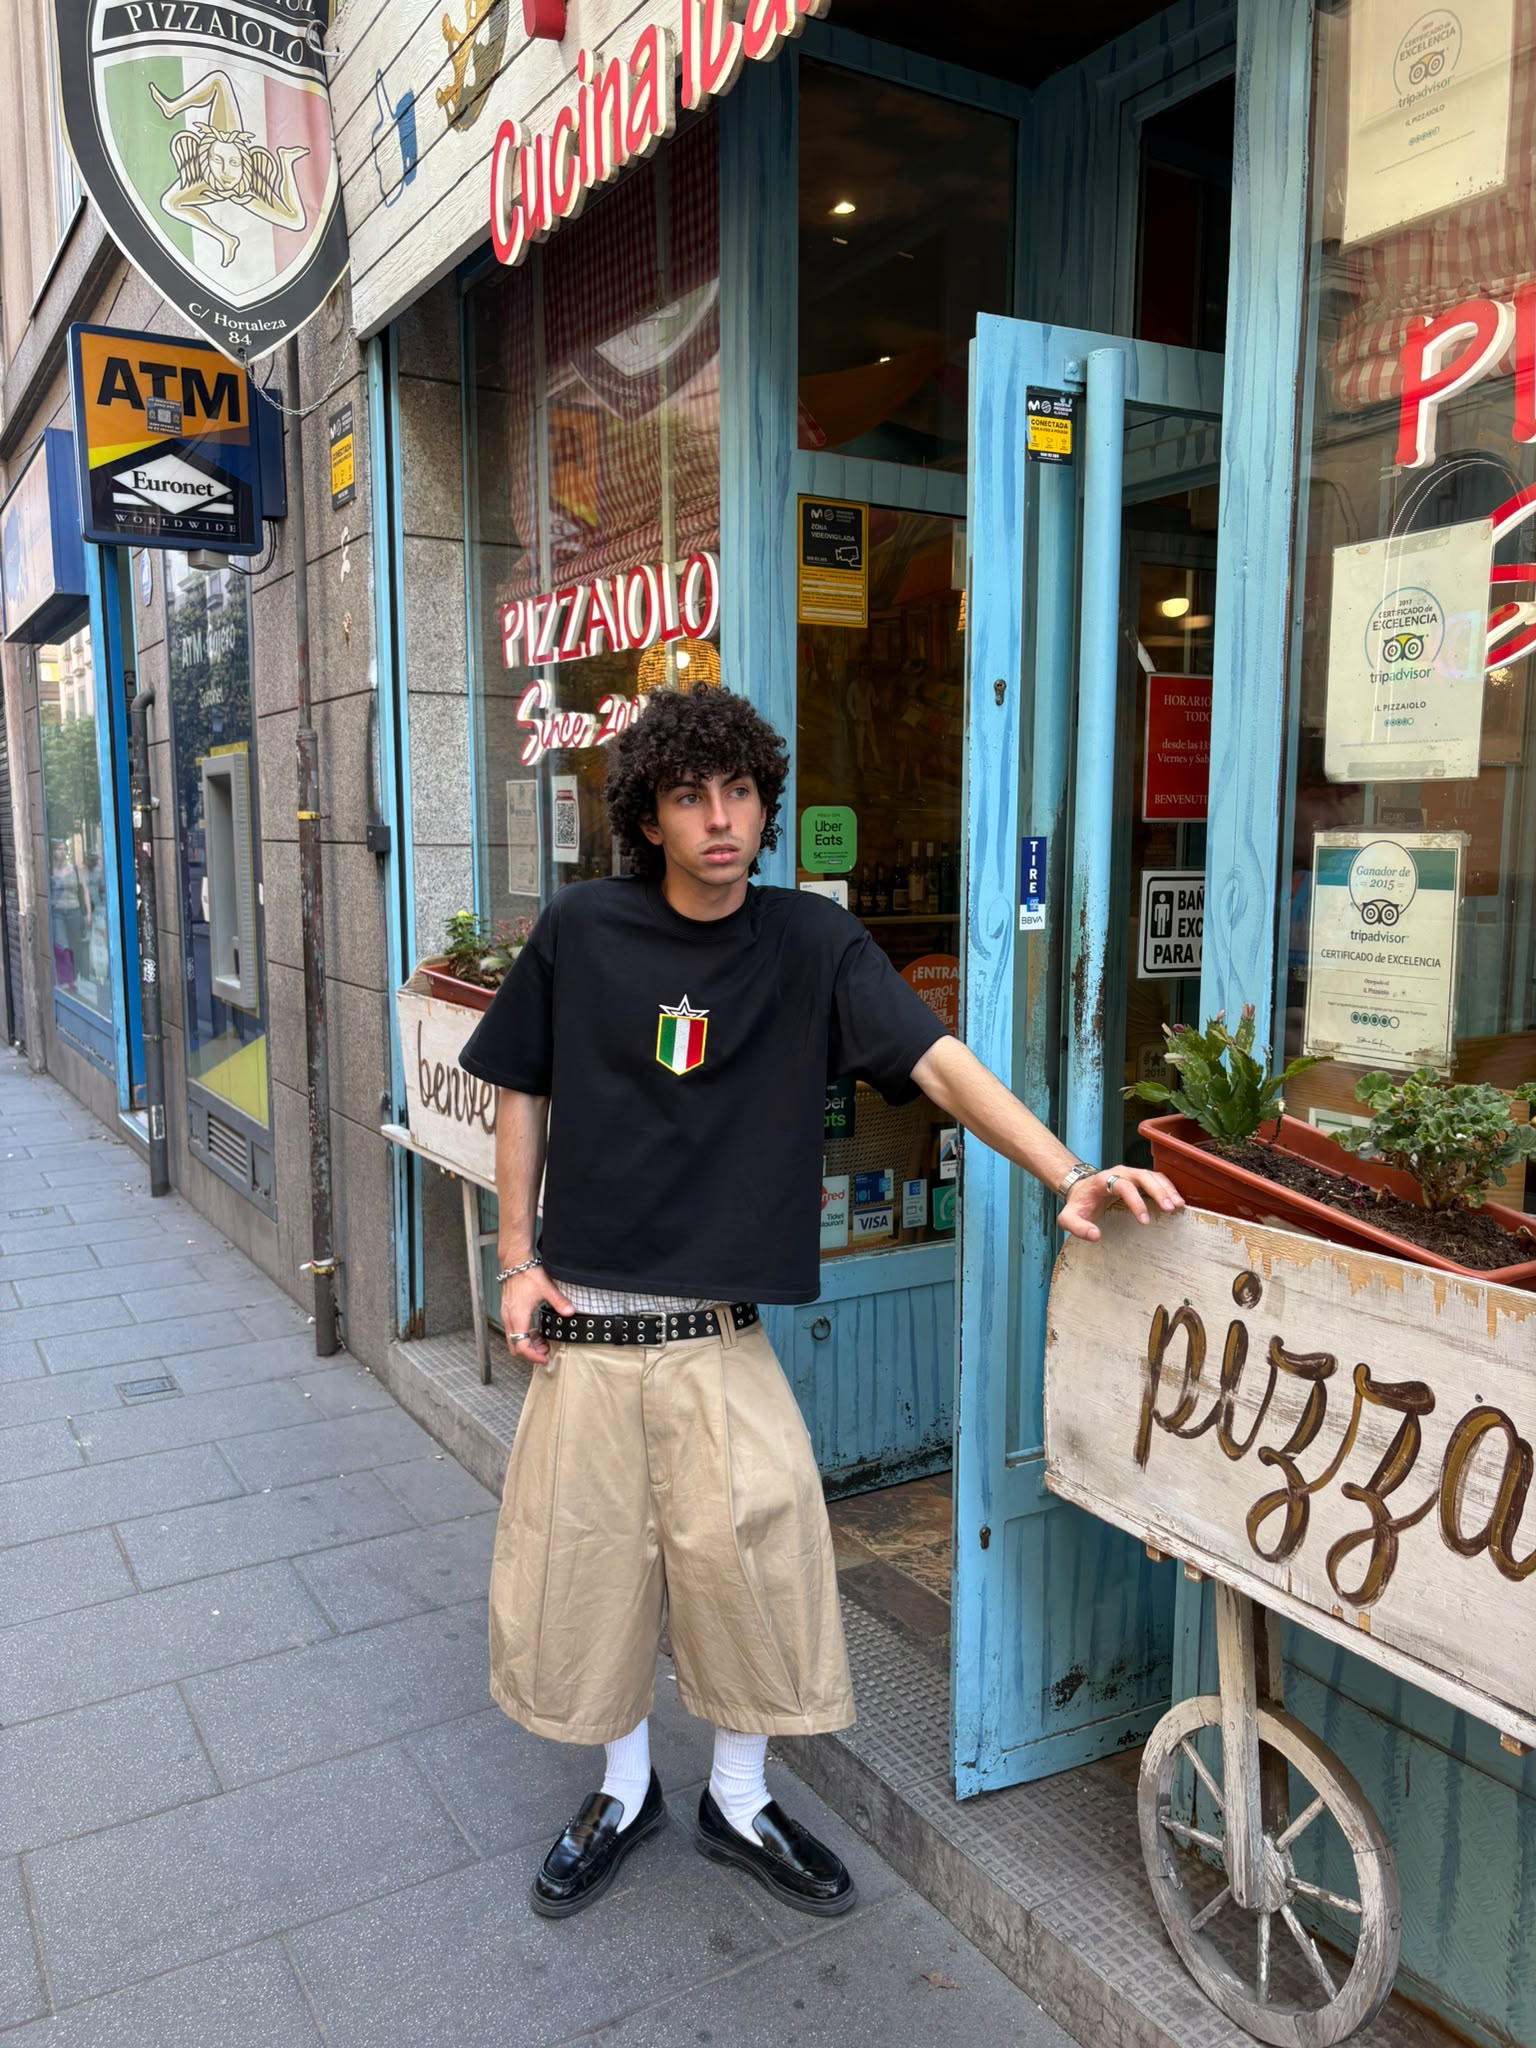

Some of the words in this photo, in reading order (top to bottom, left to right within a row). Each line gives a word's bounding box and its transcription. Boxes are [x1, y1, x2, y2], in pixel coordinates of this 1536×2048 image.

[124, 4, 304, 64] PIZZAIOLO
[1404, 25, 1444, 49] CERTIFICADO
[1399, 26, 1456, 61] EXCELENCIA
[1398, 75, 1452, 108] tripadvisor
[1412, 104, 1445, 124] PIZZAIOLO
[490, 24, 674, 266] Cucina
[188, 302, 210, 318] C/
[213, 311, 287, 331] Hortaleza
[228, 331, 252, 346] 84
[97, 356, 241, 423] ATM
[1030, 419, 1068, 429] CONECTADA
[131, 470, 214, 497] Euronet
[115, 513, 237, 533] WORLDWIDE
[811, 523, 828, 531] ZONA
[810, 531, 856, 542] VIDEOVIGILADA
[501, 551, 720, 669] PIZZAIOLO
[1378, 606, 1424, 618] CERTIFICADO
[1424, 605, 1433, 613] de
[1372, 613, 1438, 631] EXCELENCIA
[1370, 668, 1432, 685] tripadvisor
[1383, 701, 1427, 711] PIZZAIOLO
[514, 679, 594, 766] Since
[1162, 739, 1185, 750] desde
[1187, 739, 1198, 750] las
[1157, 753, 1188, 763] Viernes
[1188, 756, 1194, 766] y
[815, 820, 843, 832] Uber
[815, 834, 843, 846] Eats
[1029, 841, 1039, 893] TIRE
[1356, 865, 1398, 877] Ganador
[1399, 866, 1410, 877] de
[1370, 879, 1395, 890] 2015
[1021, 916, 1043, 924] BBVA
[1350, 929, 1407, 944] tripadvisor
[1153, 944, 1194, 964] PARA
[1321, 949, 1374, 962] CERTIFICADO
[1375, 953, 1386, 963] de
[1387, 954, 1441, 968] EXCELENCIA
[827, 1212, 845, 1220] Ticket
[858, 1215, 888, 1230] VISA
[1134, 1270, 1536, 1609] pizza
